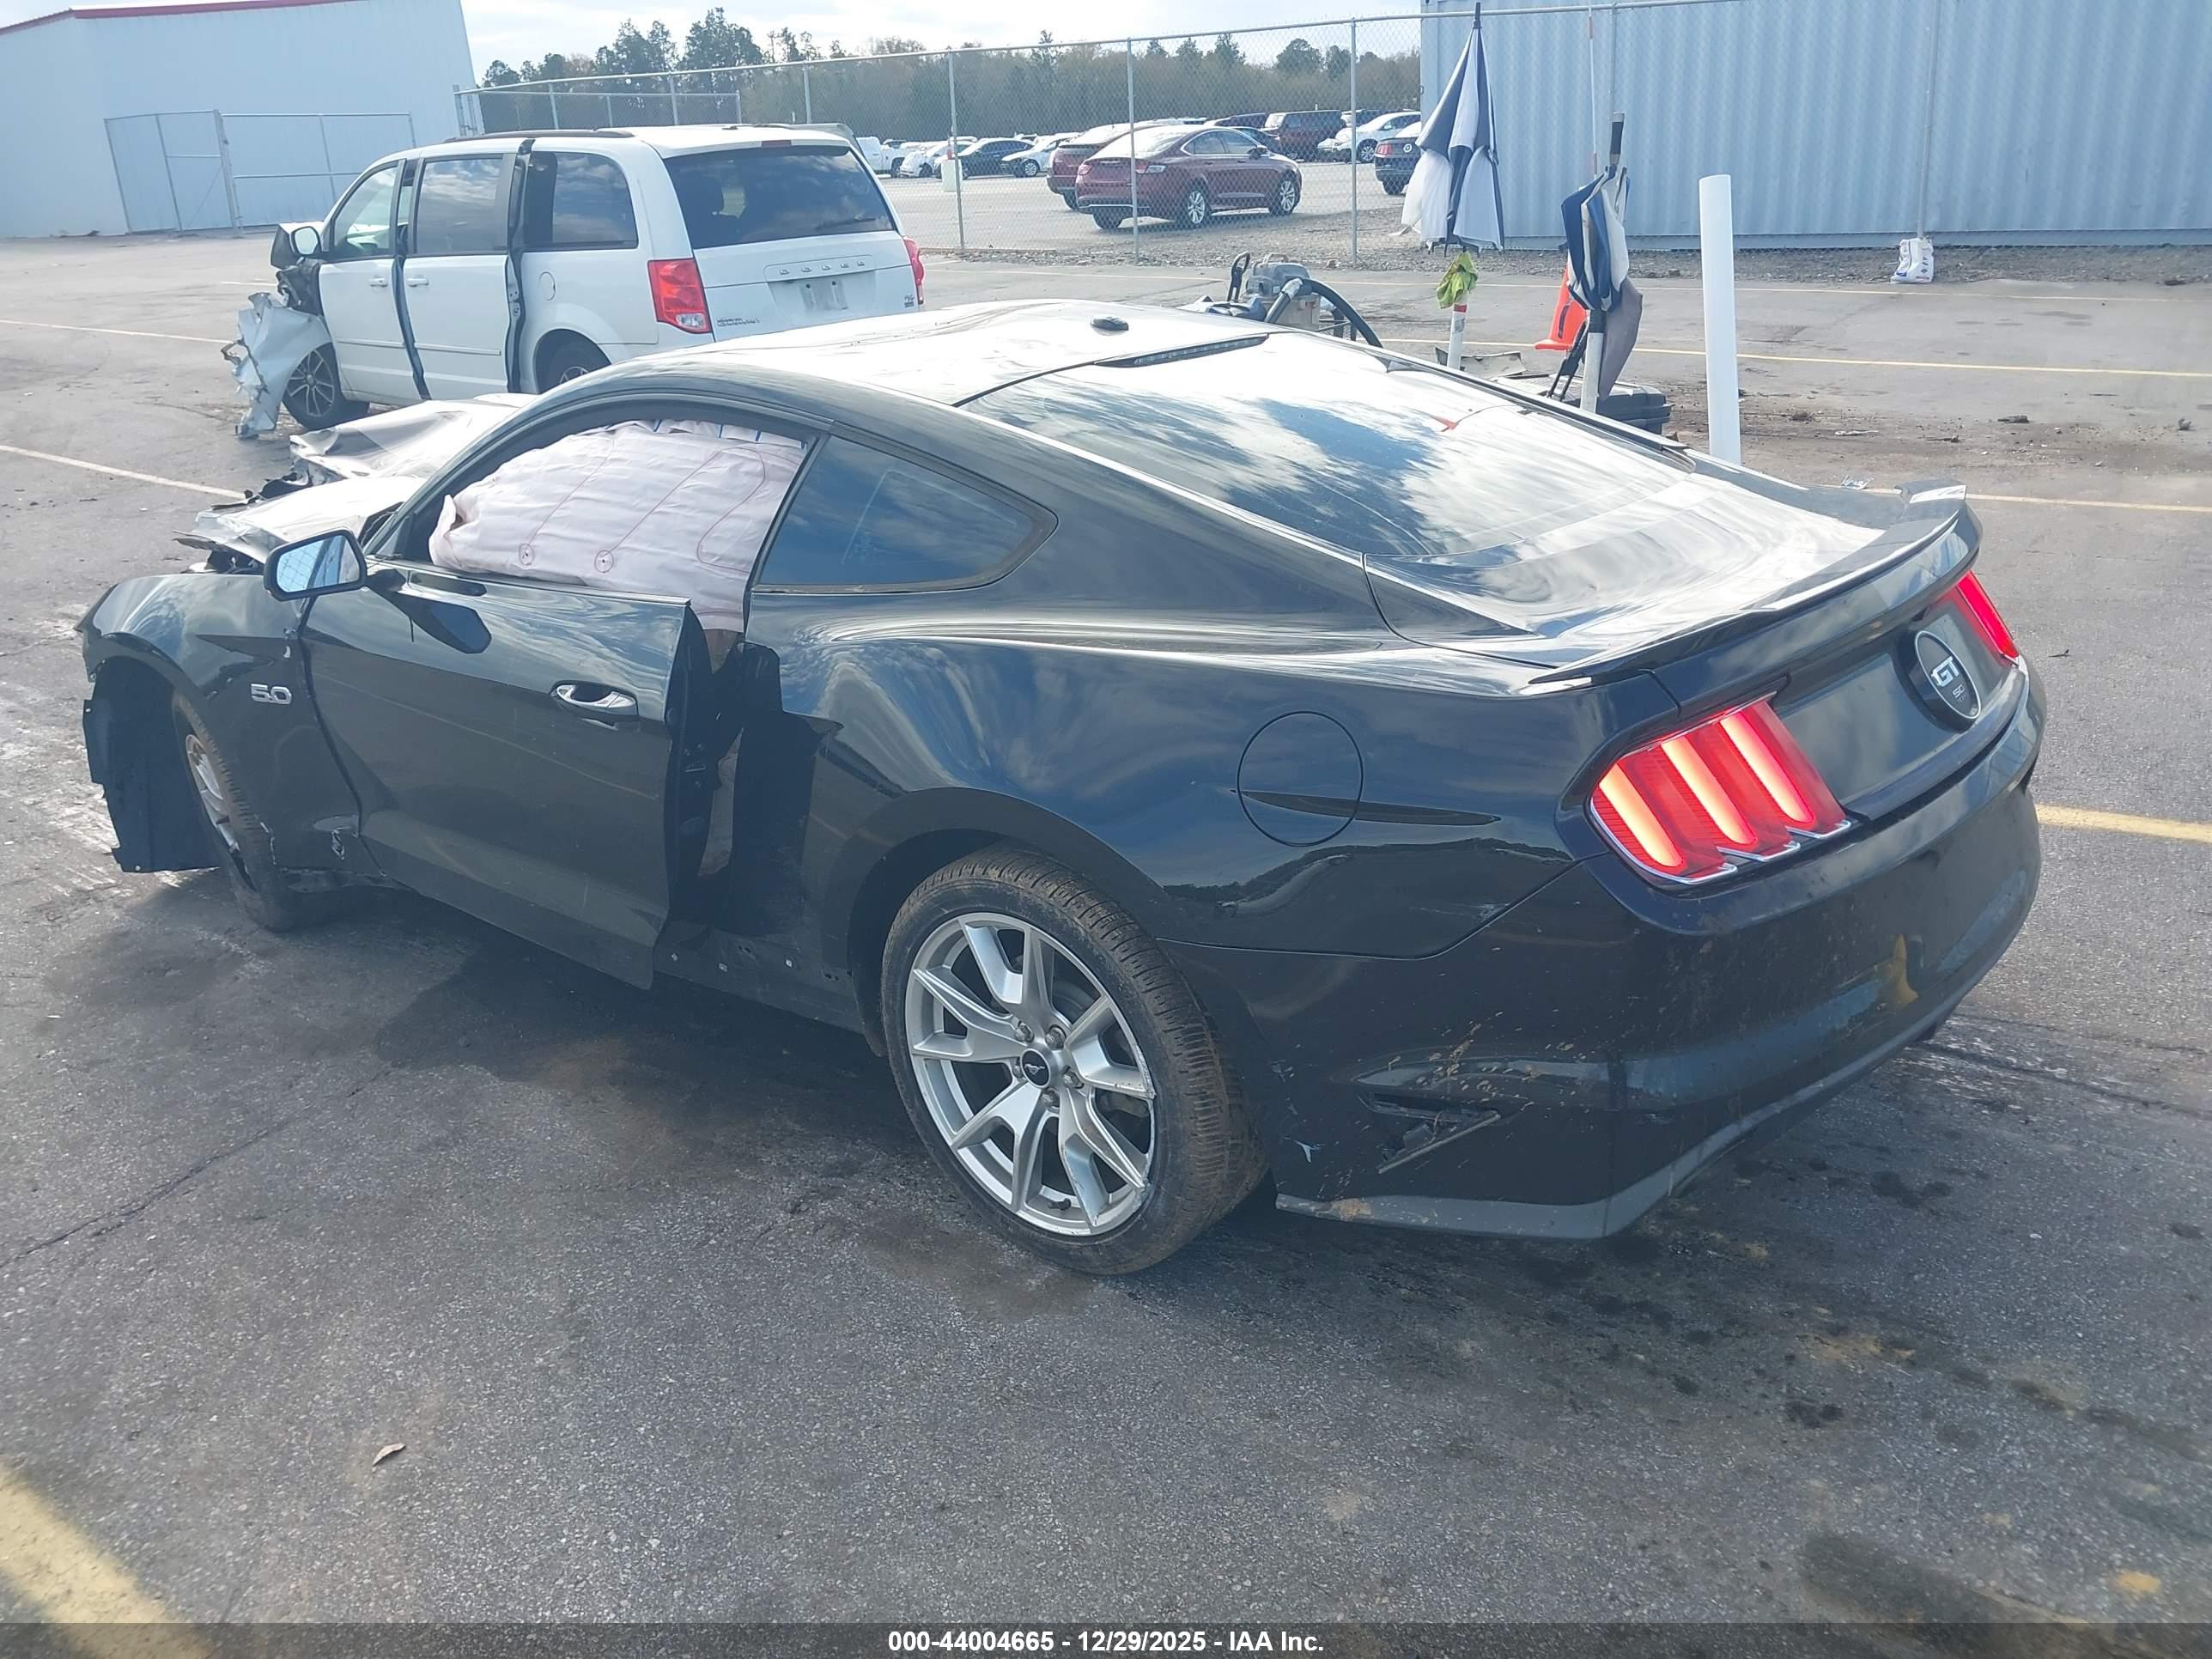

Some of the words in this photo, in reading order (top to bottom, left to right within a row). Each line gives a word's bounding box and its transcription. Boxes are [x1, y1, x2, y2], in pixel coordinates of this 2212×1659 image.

[778, 260, 866, 276] DODGE
[1930, 655, 1960, 688] GT
[250, 683, 293, 705] 5.0
